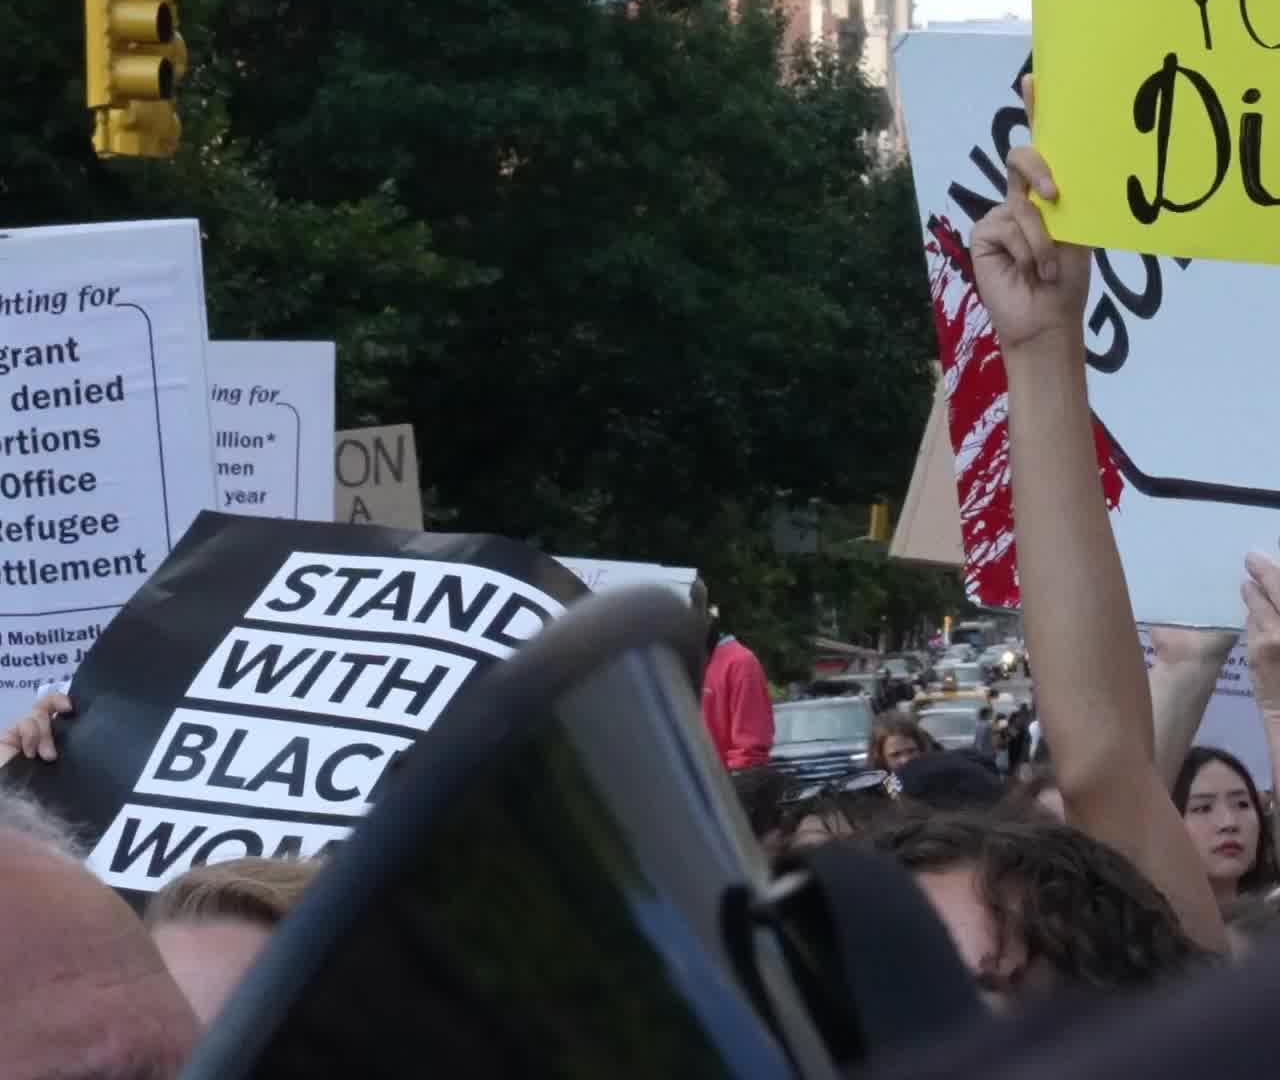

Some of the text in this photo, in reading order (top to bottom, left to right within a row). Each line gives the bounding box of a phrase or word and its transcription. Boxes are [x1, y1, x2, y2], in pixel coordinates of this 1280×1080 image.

[79, 284, 120, 313] for
[11, 375, 125, 412] denied
[249, 385, 280, 406] for
[0, 469, 97, 499] Office
[224, 490, 266, 506] year
[265, 564, 551, 643] STAND
[217, 639, 449, 716] WITH
